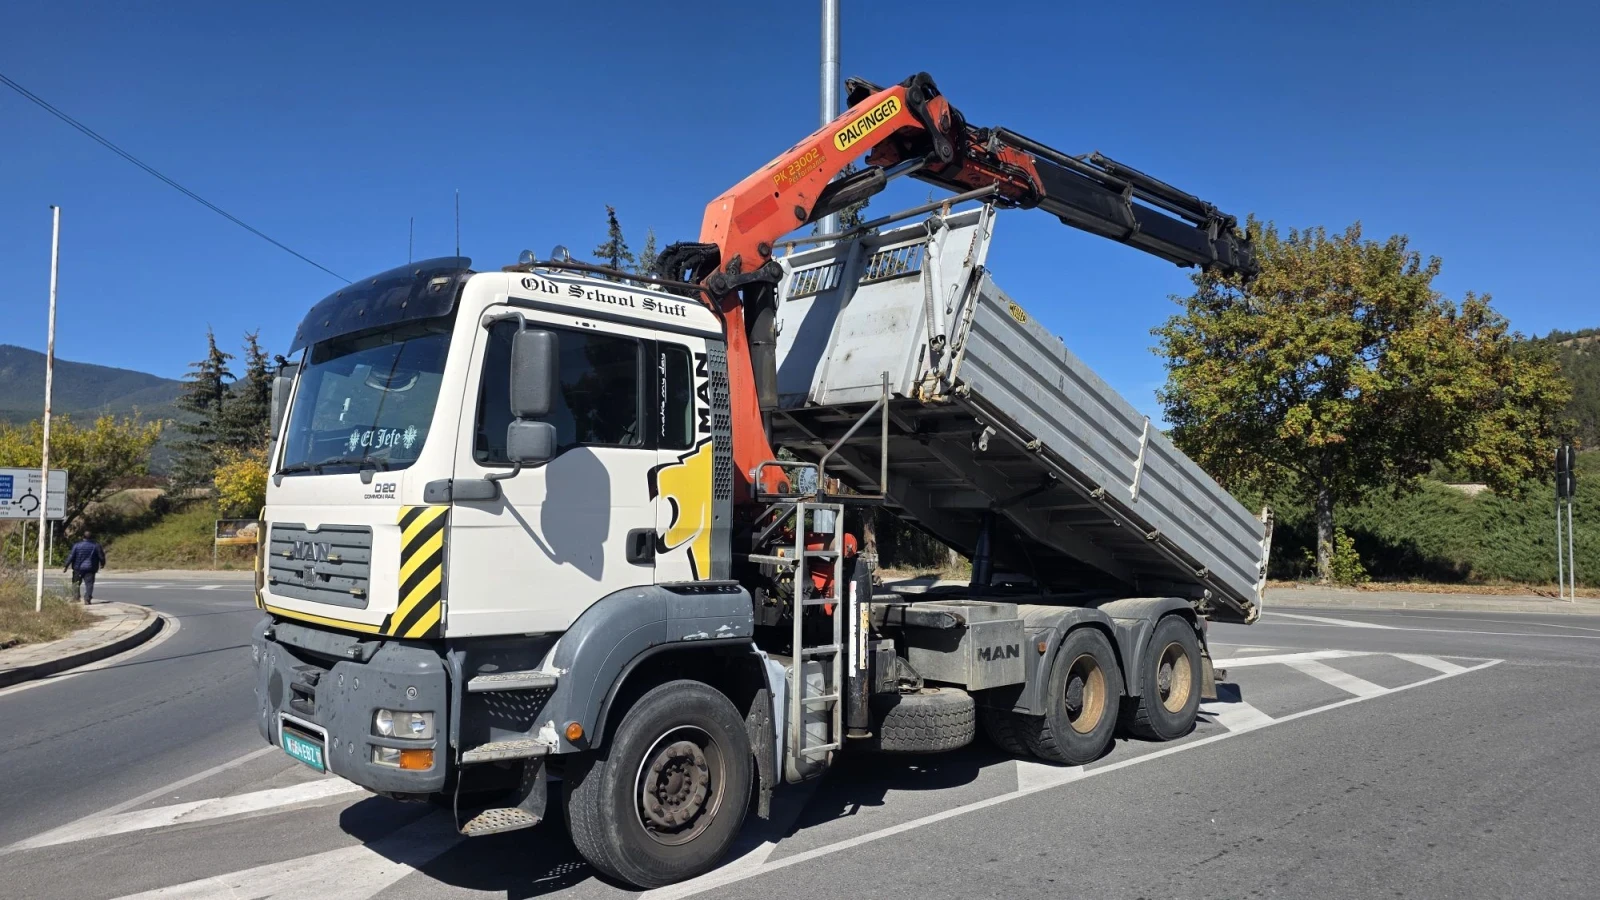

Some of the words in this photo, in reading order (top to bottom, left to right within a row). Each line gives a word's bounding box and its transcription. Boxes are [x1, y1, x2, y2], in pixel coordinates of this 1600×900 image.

[838, 99, 897, 147] PALFINGER
[773, 171, 786, 186] PK
[788, 147, 819, 175] 23002
[788, 156, 826, 185] Performance
[521, 277, 559, 294] Old
[568, 285, 635, 308] School
[642, 298, 687, 317] Stuff
[658, 353, 667, 375] day
[661, 378, 667, 398] my
[694, 352, 711, 433] MAN
[360, 430, 375, 447] El
[375, 428, 401, 449] Jefe
[293, 541, 332, 561] MAN
[977, 644, 1020, 661] MAN
